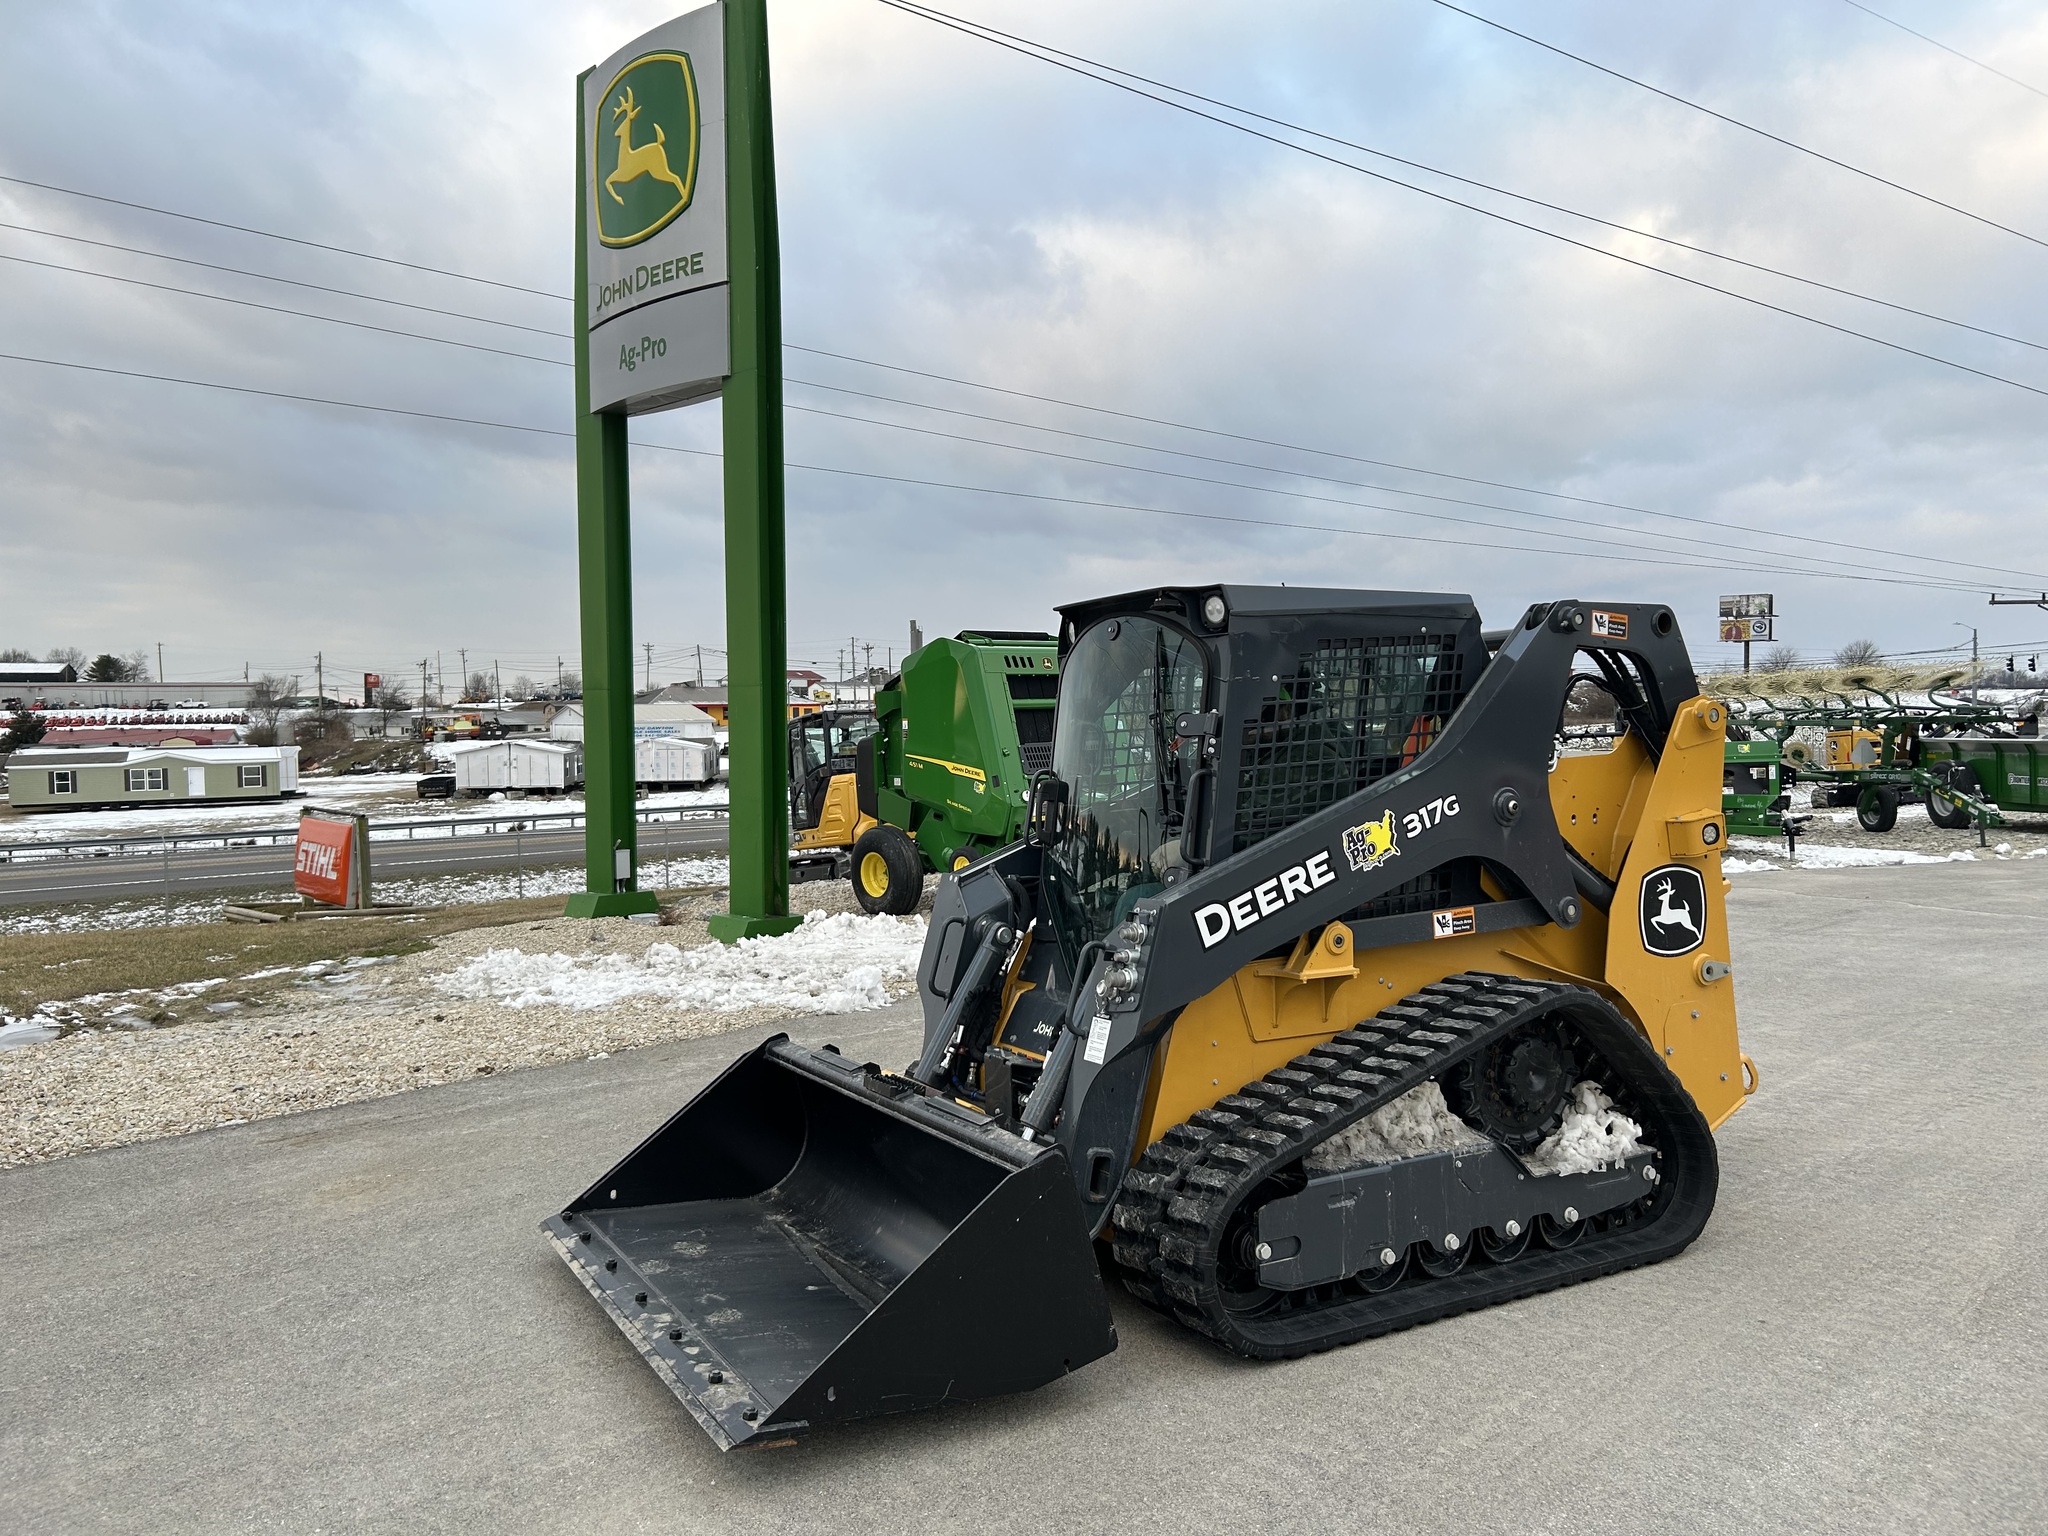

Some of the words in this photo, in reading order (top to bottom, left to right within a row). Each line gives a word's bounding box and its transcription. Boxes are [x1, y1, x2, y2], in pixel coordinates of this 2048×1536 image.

[596, 275, 633, 312] JOHN
[636, 252, 704, 293] DEERE
[619, 336, 667, 372] Ag-Pro
[952, 765, 965, 773] JOHN
[965, 768, 981, 777] DEERE
[1402, 795, 1461, 839] 317G
[1346, 829, 1370, 850] Ag-
[1350, 843, 1376, 866] Pro
[296, 841, 338, 880] STIHL
[1194, 850, 1336, 949] DEERE
